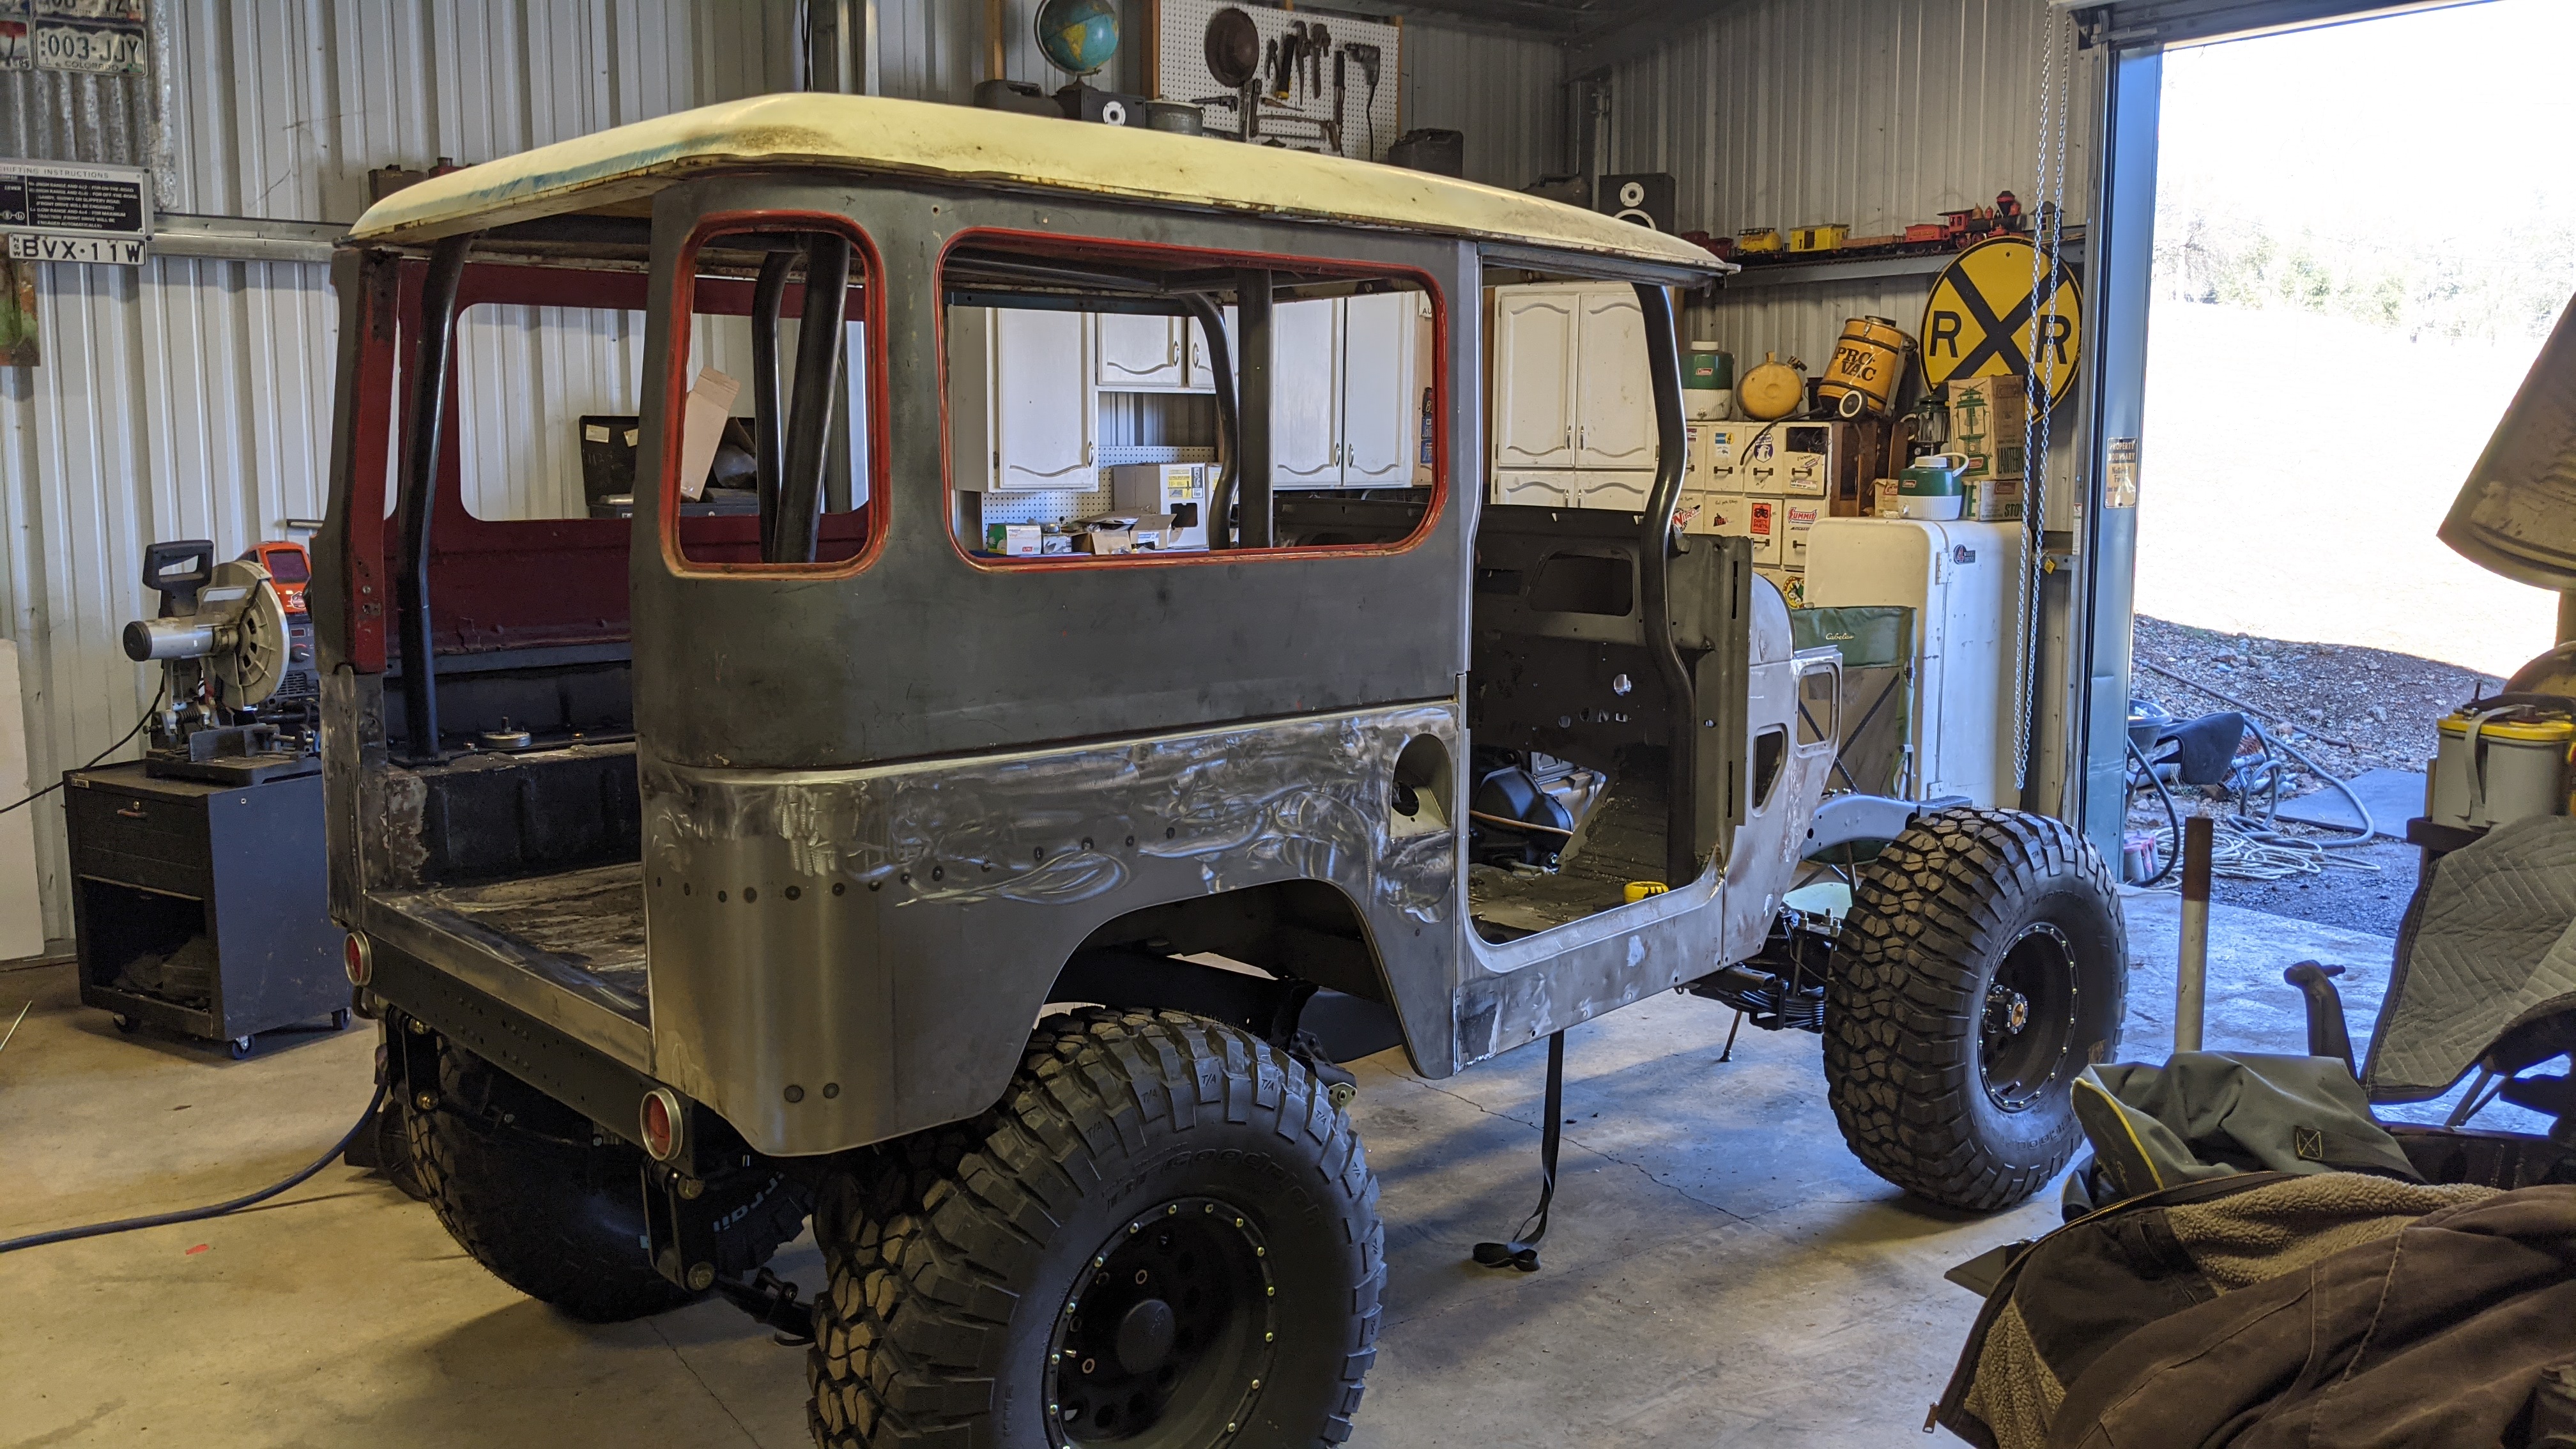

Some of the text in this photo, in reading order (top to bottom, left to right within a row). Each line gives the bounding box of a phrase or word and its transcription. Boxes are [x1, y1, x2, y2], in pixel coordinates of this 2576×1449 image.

[65, 61, 119, 71] COLORADO
[0, 166, 109, 178] HIFTING INSTRUCTIONS
[1841, 361, 1877, 381] VAC
[2109, 441, 2135, 450] PROPERTY
[1789, 507, 1816, 521] SUMMIT
[1201, 1074, 1217, 1086] T/A
[1261, 1077, 1276, 1092] T/A
[1141, 1089, 1159, 1104] T/A
[1315, 1110, 1328, 1126] T/A
